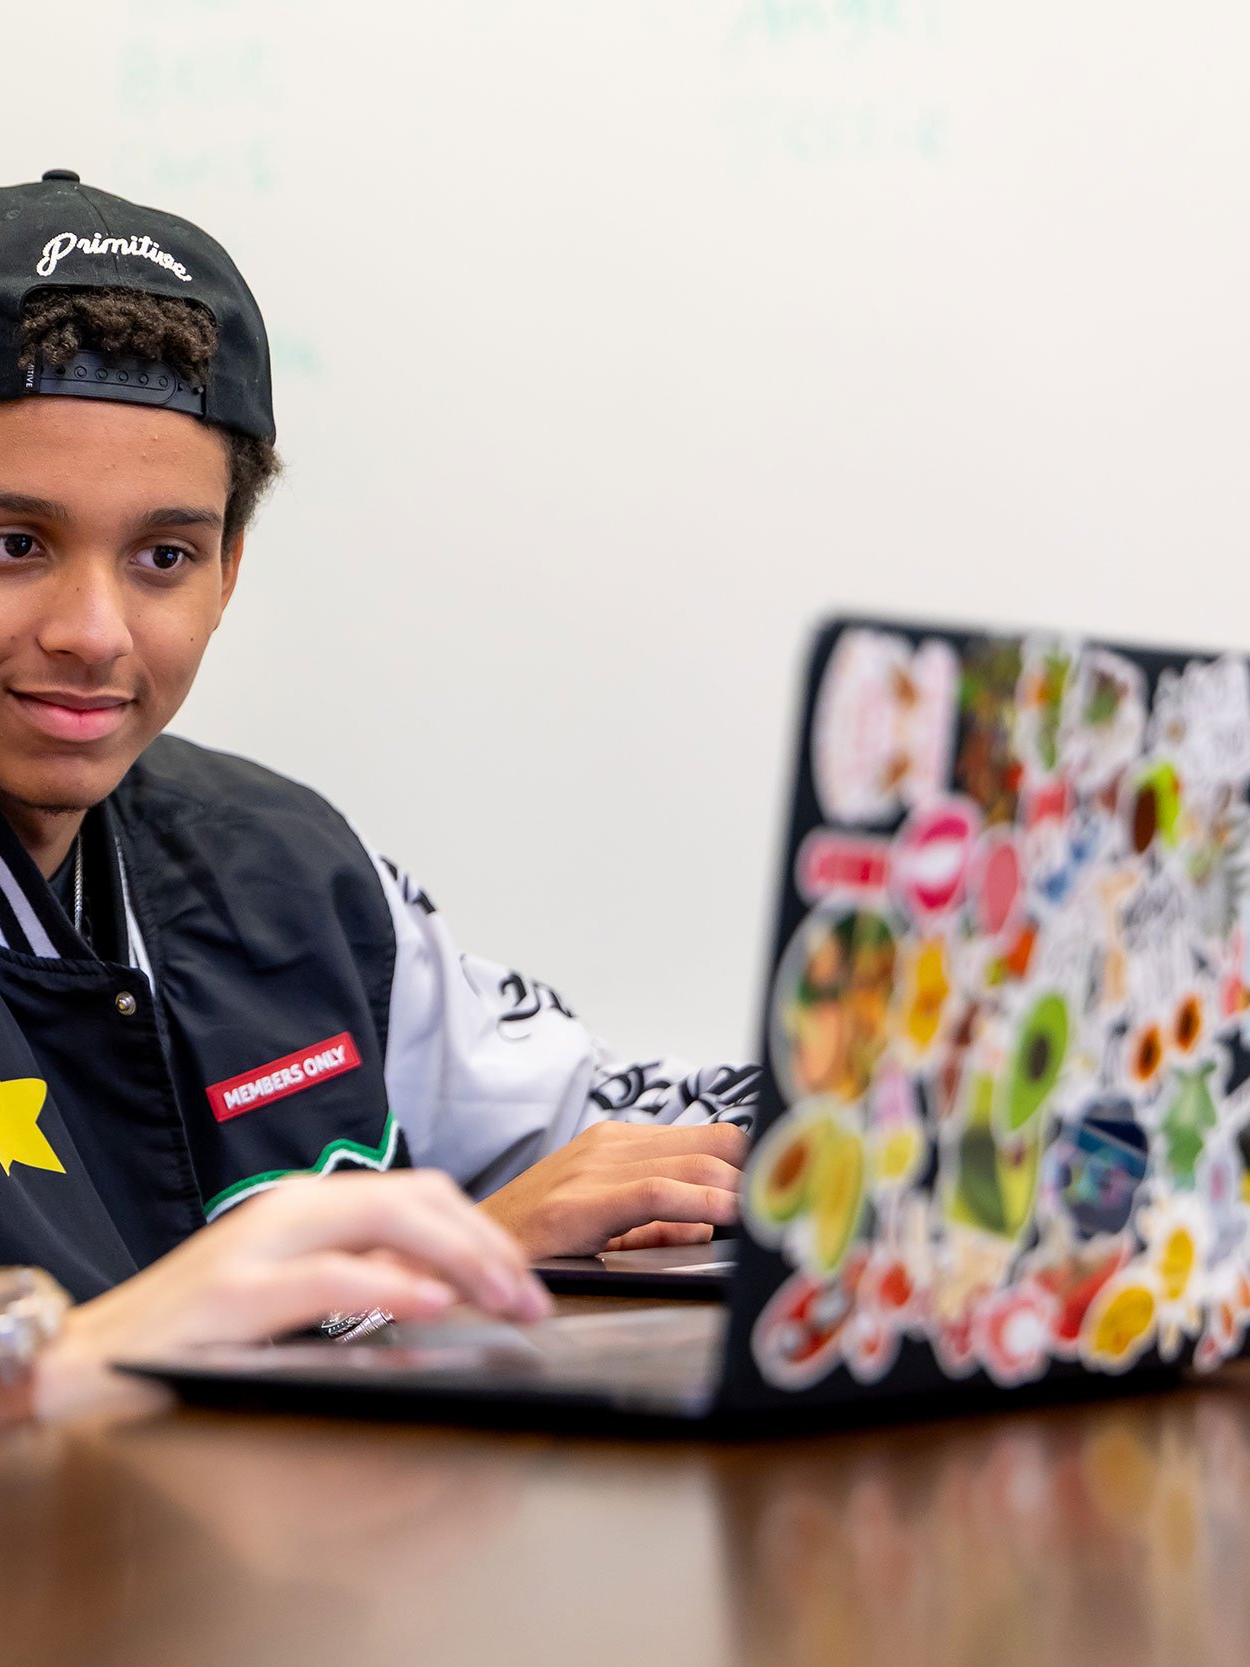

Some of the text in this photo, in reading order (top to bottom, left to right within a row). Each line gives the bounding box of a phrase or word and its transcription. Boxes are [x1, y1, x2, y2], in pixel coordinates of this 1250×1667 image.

[36, 232, 192, 281] Primitive
[223, 1045, 346, 1109] MEMBERS ONLY
